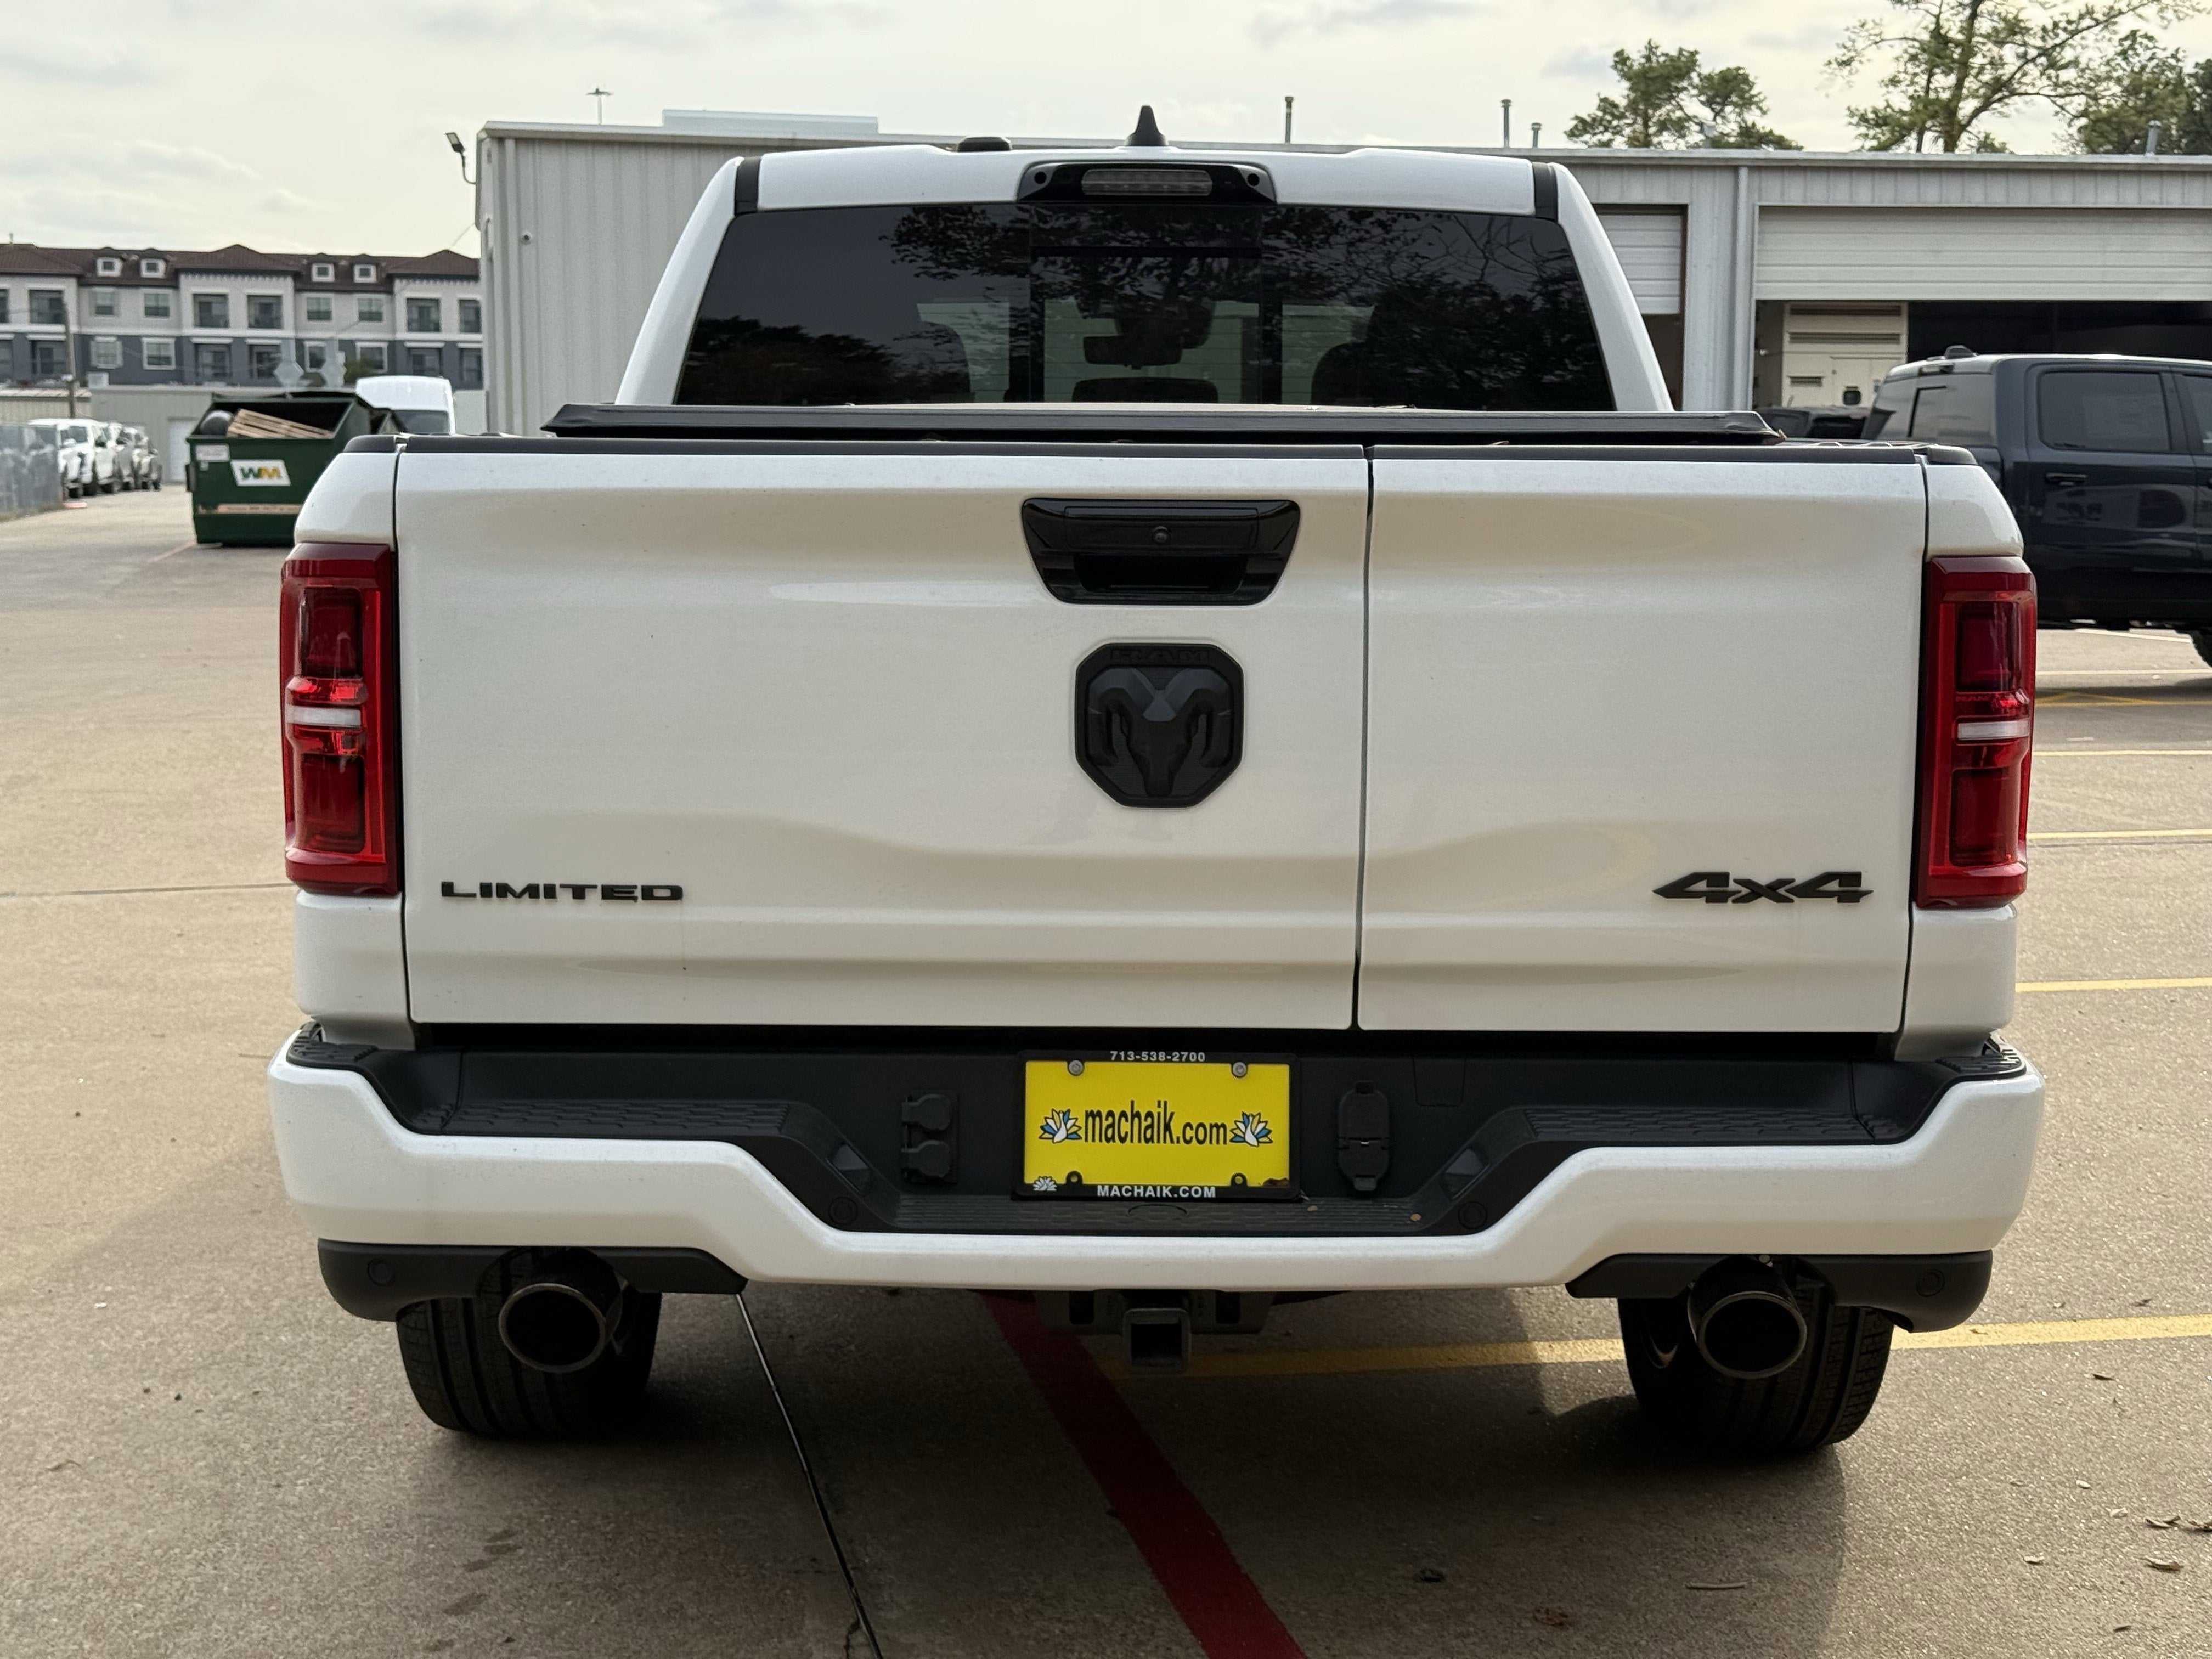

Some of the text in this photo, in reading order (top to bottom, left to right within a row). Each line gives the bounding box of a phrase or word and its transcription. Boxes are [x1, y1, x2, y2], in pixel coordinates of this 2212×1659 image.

[1109, 649, 1210, 661] RAM
[441, 881, 684, 901] LIMITED
[1652, 871, 1875, 904] 4x4
[1110, 1051, 1206, 1063] 713-538-2700
[1084, 1099, 1227, 1146] machaik.com
[1097, 1184, 1216, 1199] MACHAIK.COM
